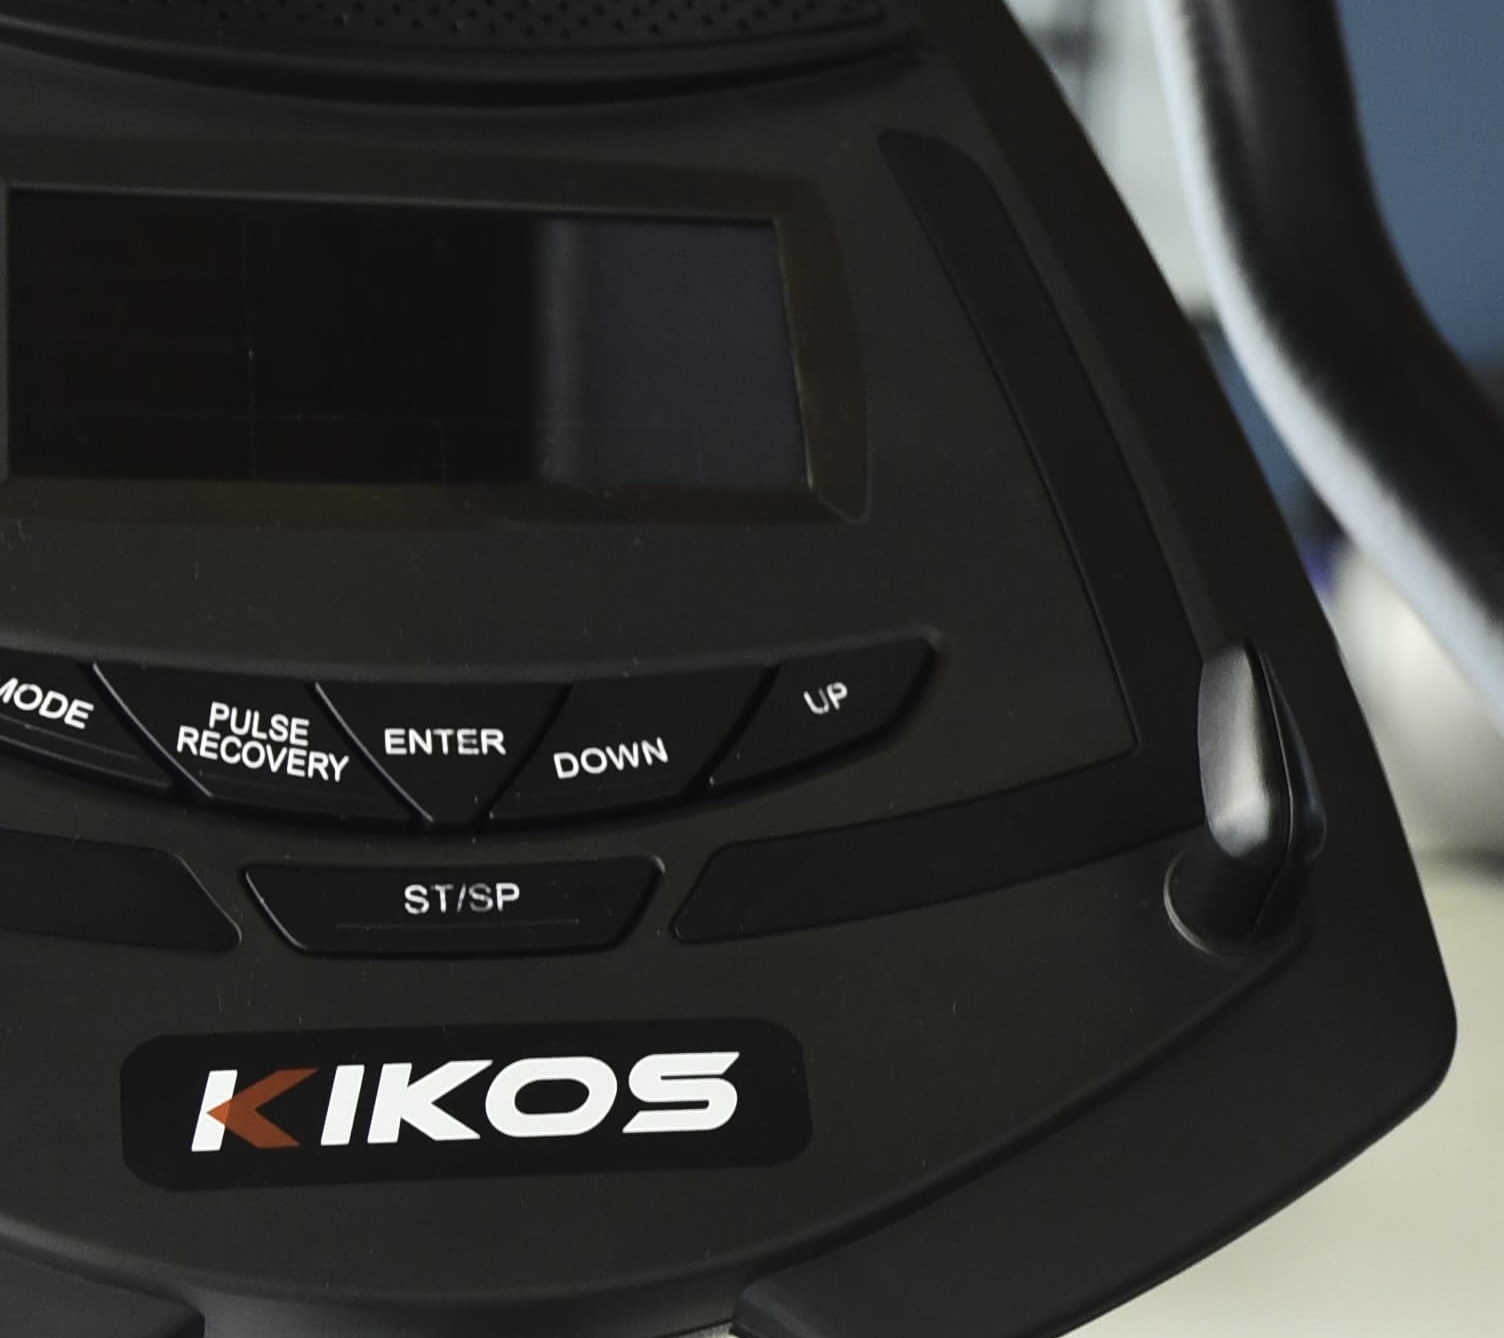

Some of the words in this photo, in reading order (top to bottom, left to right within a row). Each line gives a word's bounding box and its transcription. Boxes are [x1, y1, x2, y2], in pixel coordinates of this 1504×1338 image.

[802, 681, 849, 715] UP
[208, 701, 311, 747] PULSE
[383, 727, 507, 756] ENTER
[175, 724, 350, 783] RECOVERY
[552, 736, 669, 780] DOWN
[403, 881, 521, 915] ST/SP
[191, 1051, 742, 1153] KIKOS
